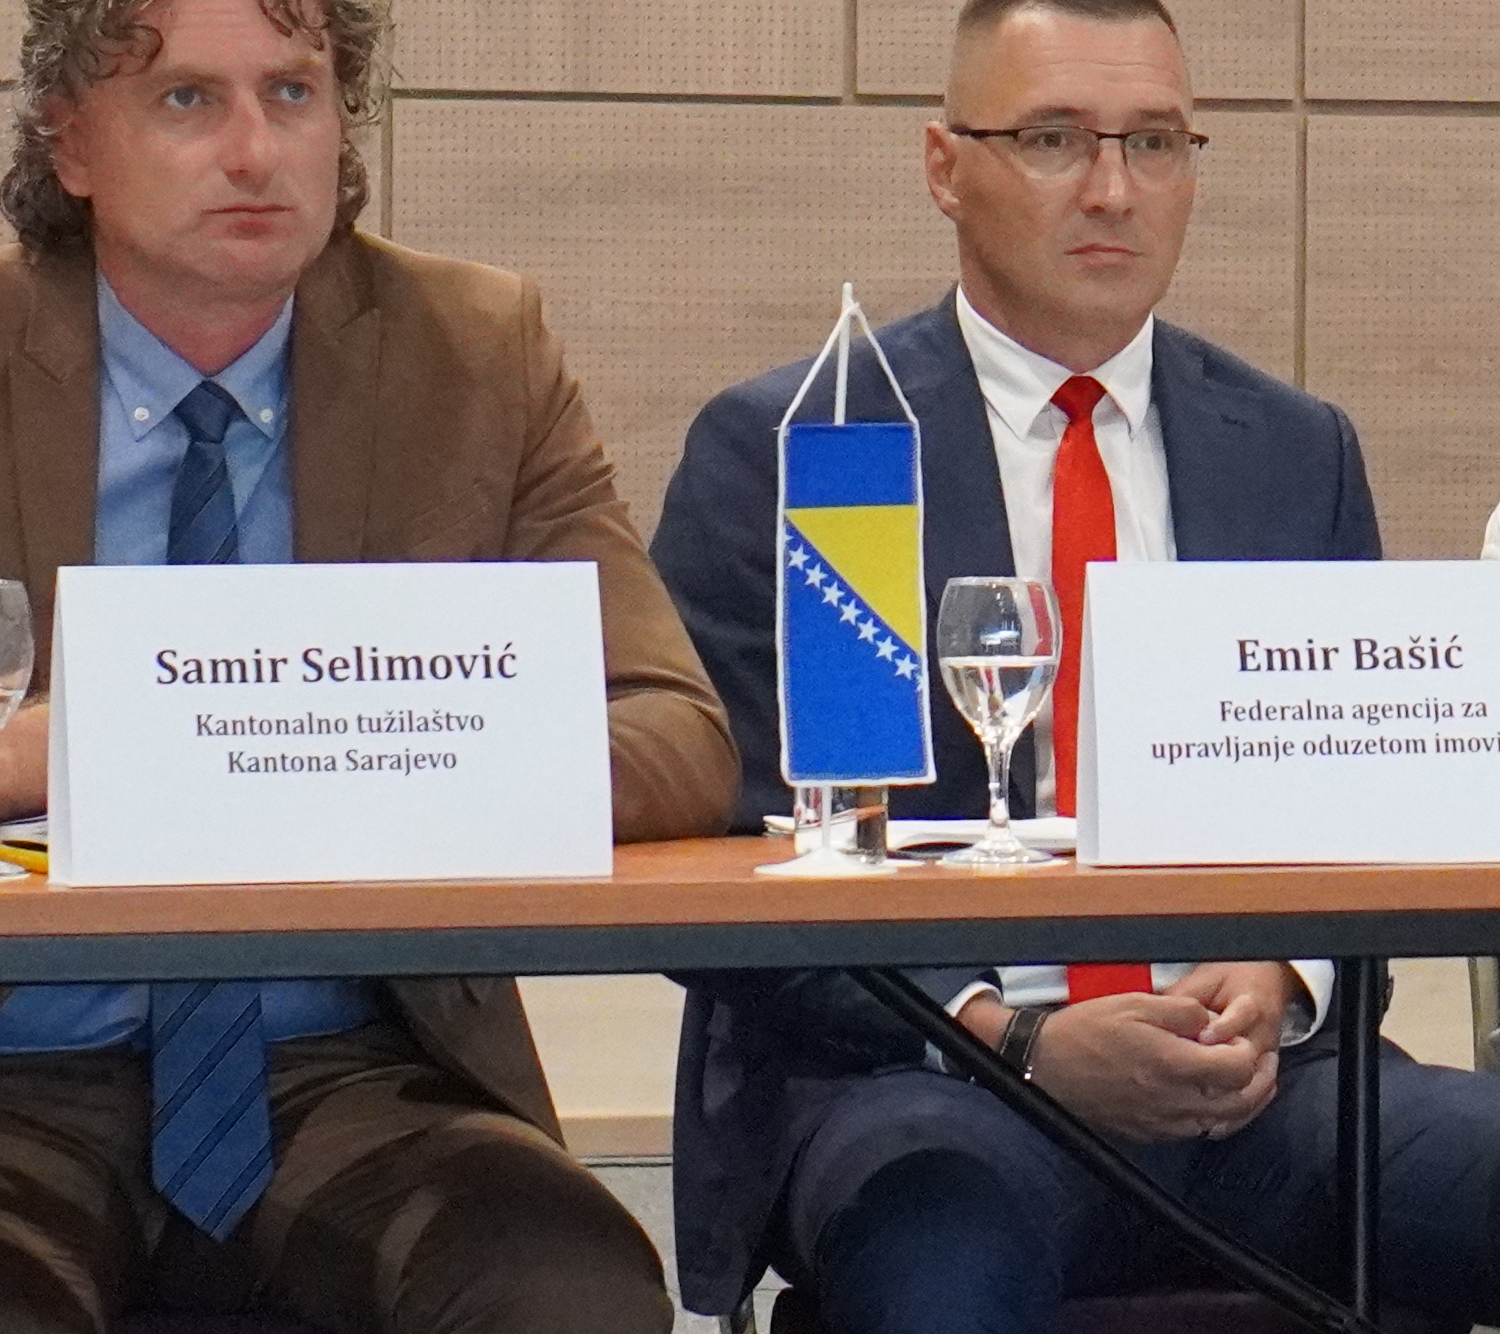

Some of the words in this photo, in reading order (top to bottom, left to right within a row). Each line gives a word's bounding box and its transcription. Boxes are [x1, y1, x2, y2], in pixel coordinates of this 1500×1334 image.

[156, 648, 288, 685] Samir
[301, 642, 517, 683] Selimović
[1237, 638, 1340, 672] Emir
[1353, 634, 1463, 671] Bašić
[196, 711, 349, 737] Kantonalno
[356, 709, 485, 734] tužilaštvo
[1220, 698, 1344, 722] Federalna
[1351, 697, 1454, 726] agencija
[1461, 702, 1488, 718] za
[228, 751, 337, 774] Kantona
[345, 748, 458, 776] Sarajevo
[1151, 735, 1295, 765] upravljanje
[1302, 733, 1427, 756] oduzetom
